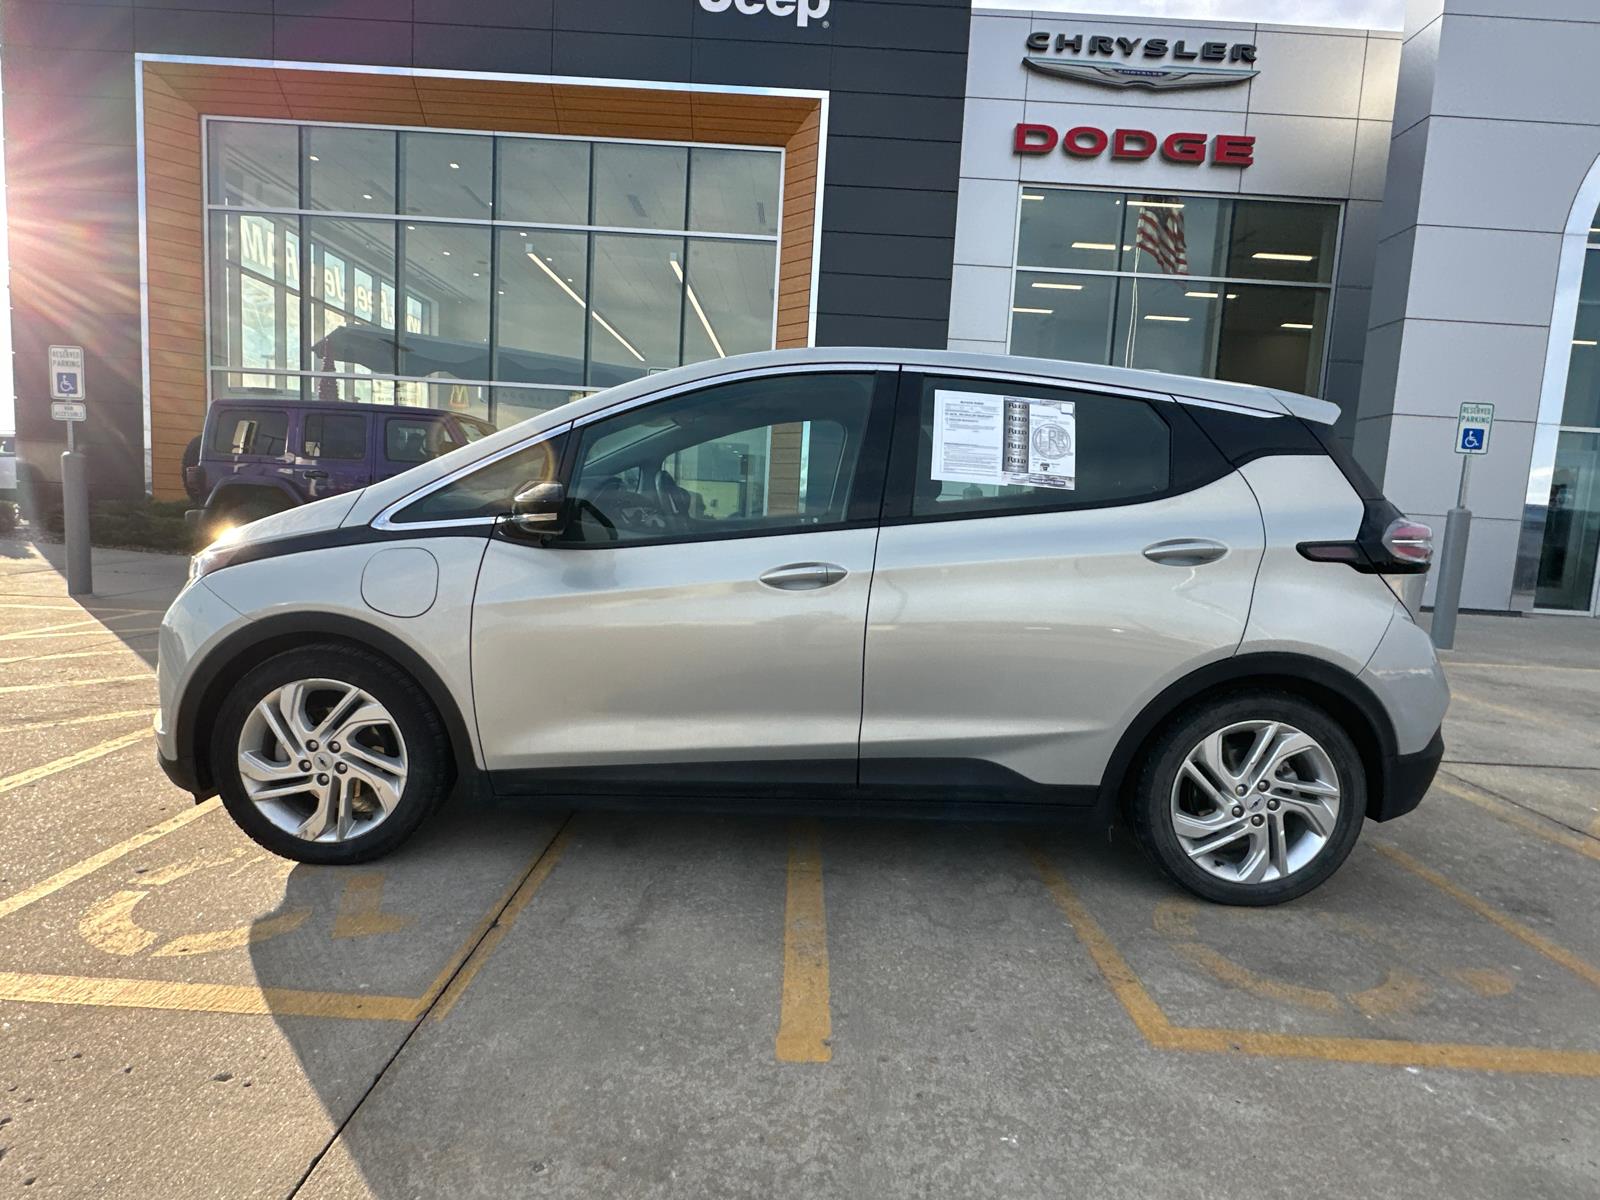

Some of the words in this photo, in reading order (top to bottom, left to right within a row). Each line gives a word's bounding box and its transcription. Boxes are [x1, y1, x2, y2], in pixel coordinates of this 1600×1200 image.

[1026, 32, 1257, 62] CHRYSLER
[1013, 123, 1256, 168] DODGE
[52, 359, 81, 368] PARKING
[1463, 406, 1491, 415] RESERVED
[1460, 415, 1490, 424] PARKING
